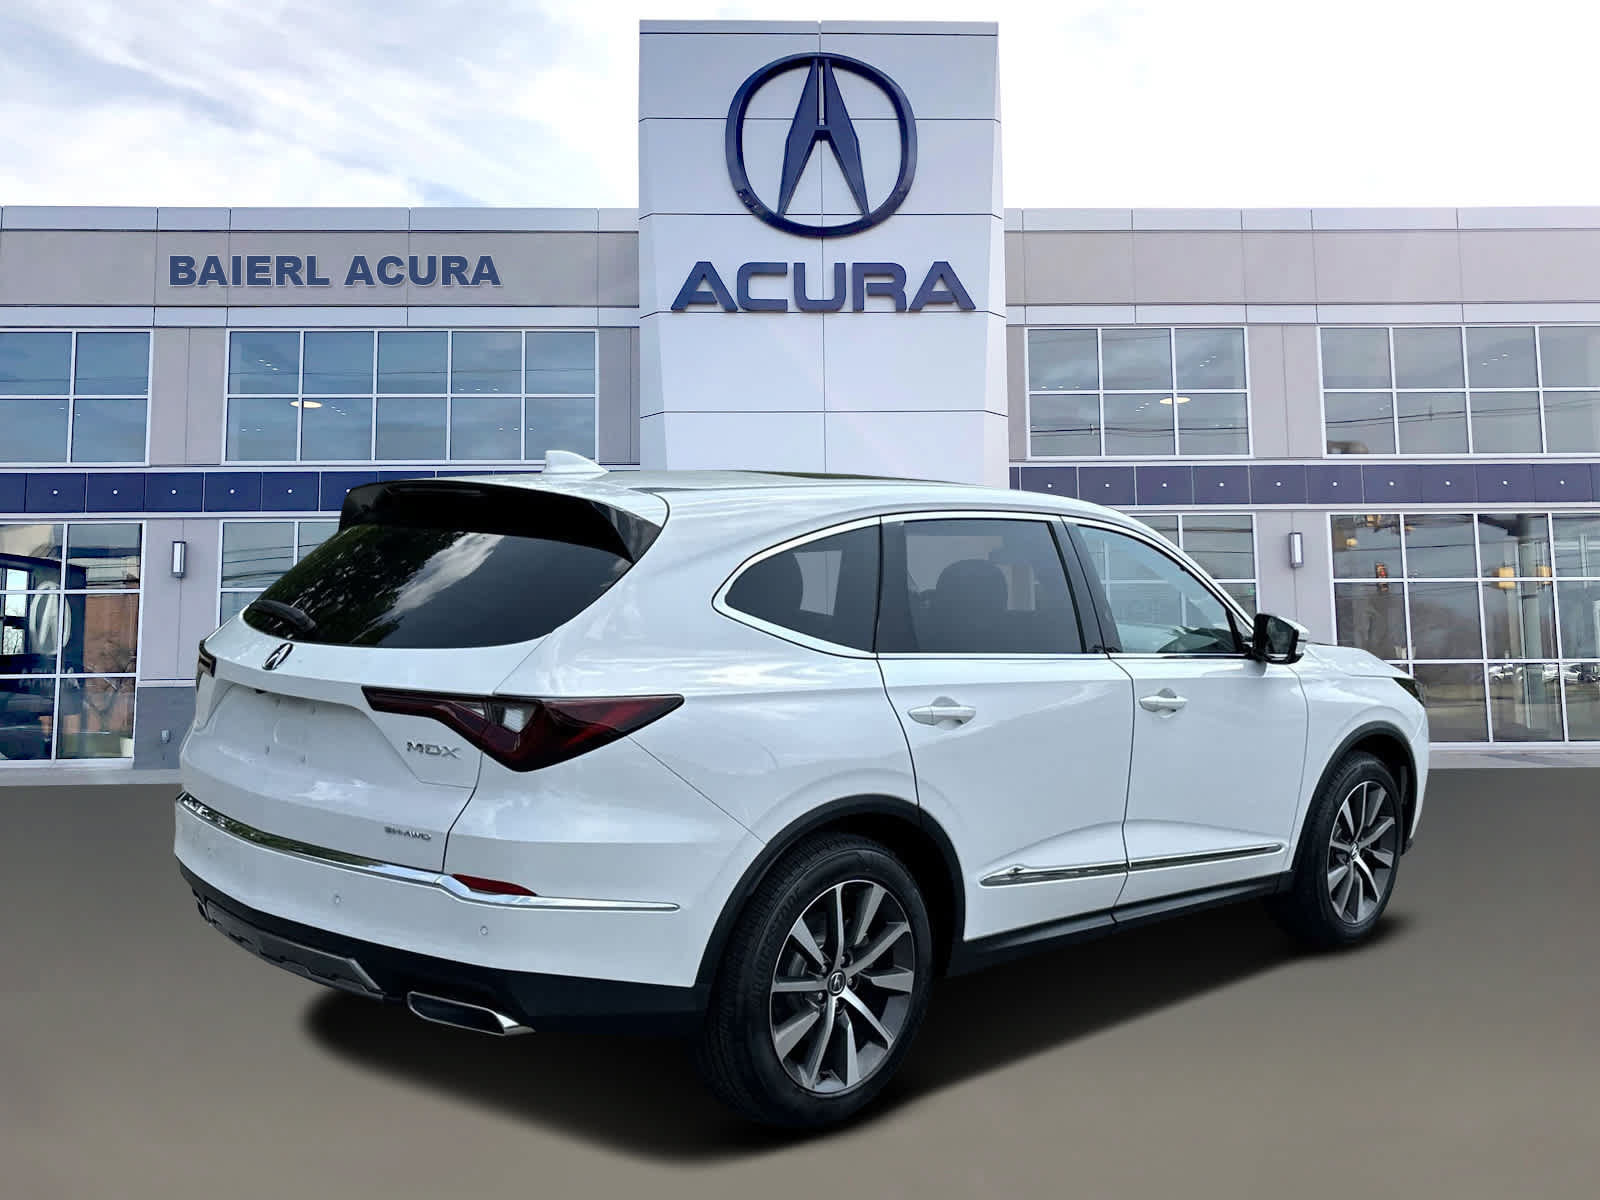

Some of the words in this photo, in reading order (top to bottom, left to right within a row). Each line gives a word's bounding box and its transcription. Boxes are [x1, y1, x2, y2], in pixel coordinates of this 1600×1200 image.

[168, 255, 331, 287] BAIERL
[343, 255, 502, 287] ACURA
[670, 260, 977, 313] ACURA
[406, 741, 461, 760] MDX
